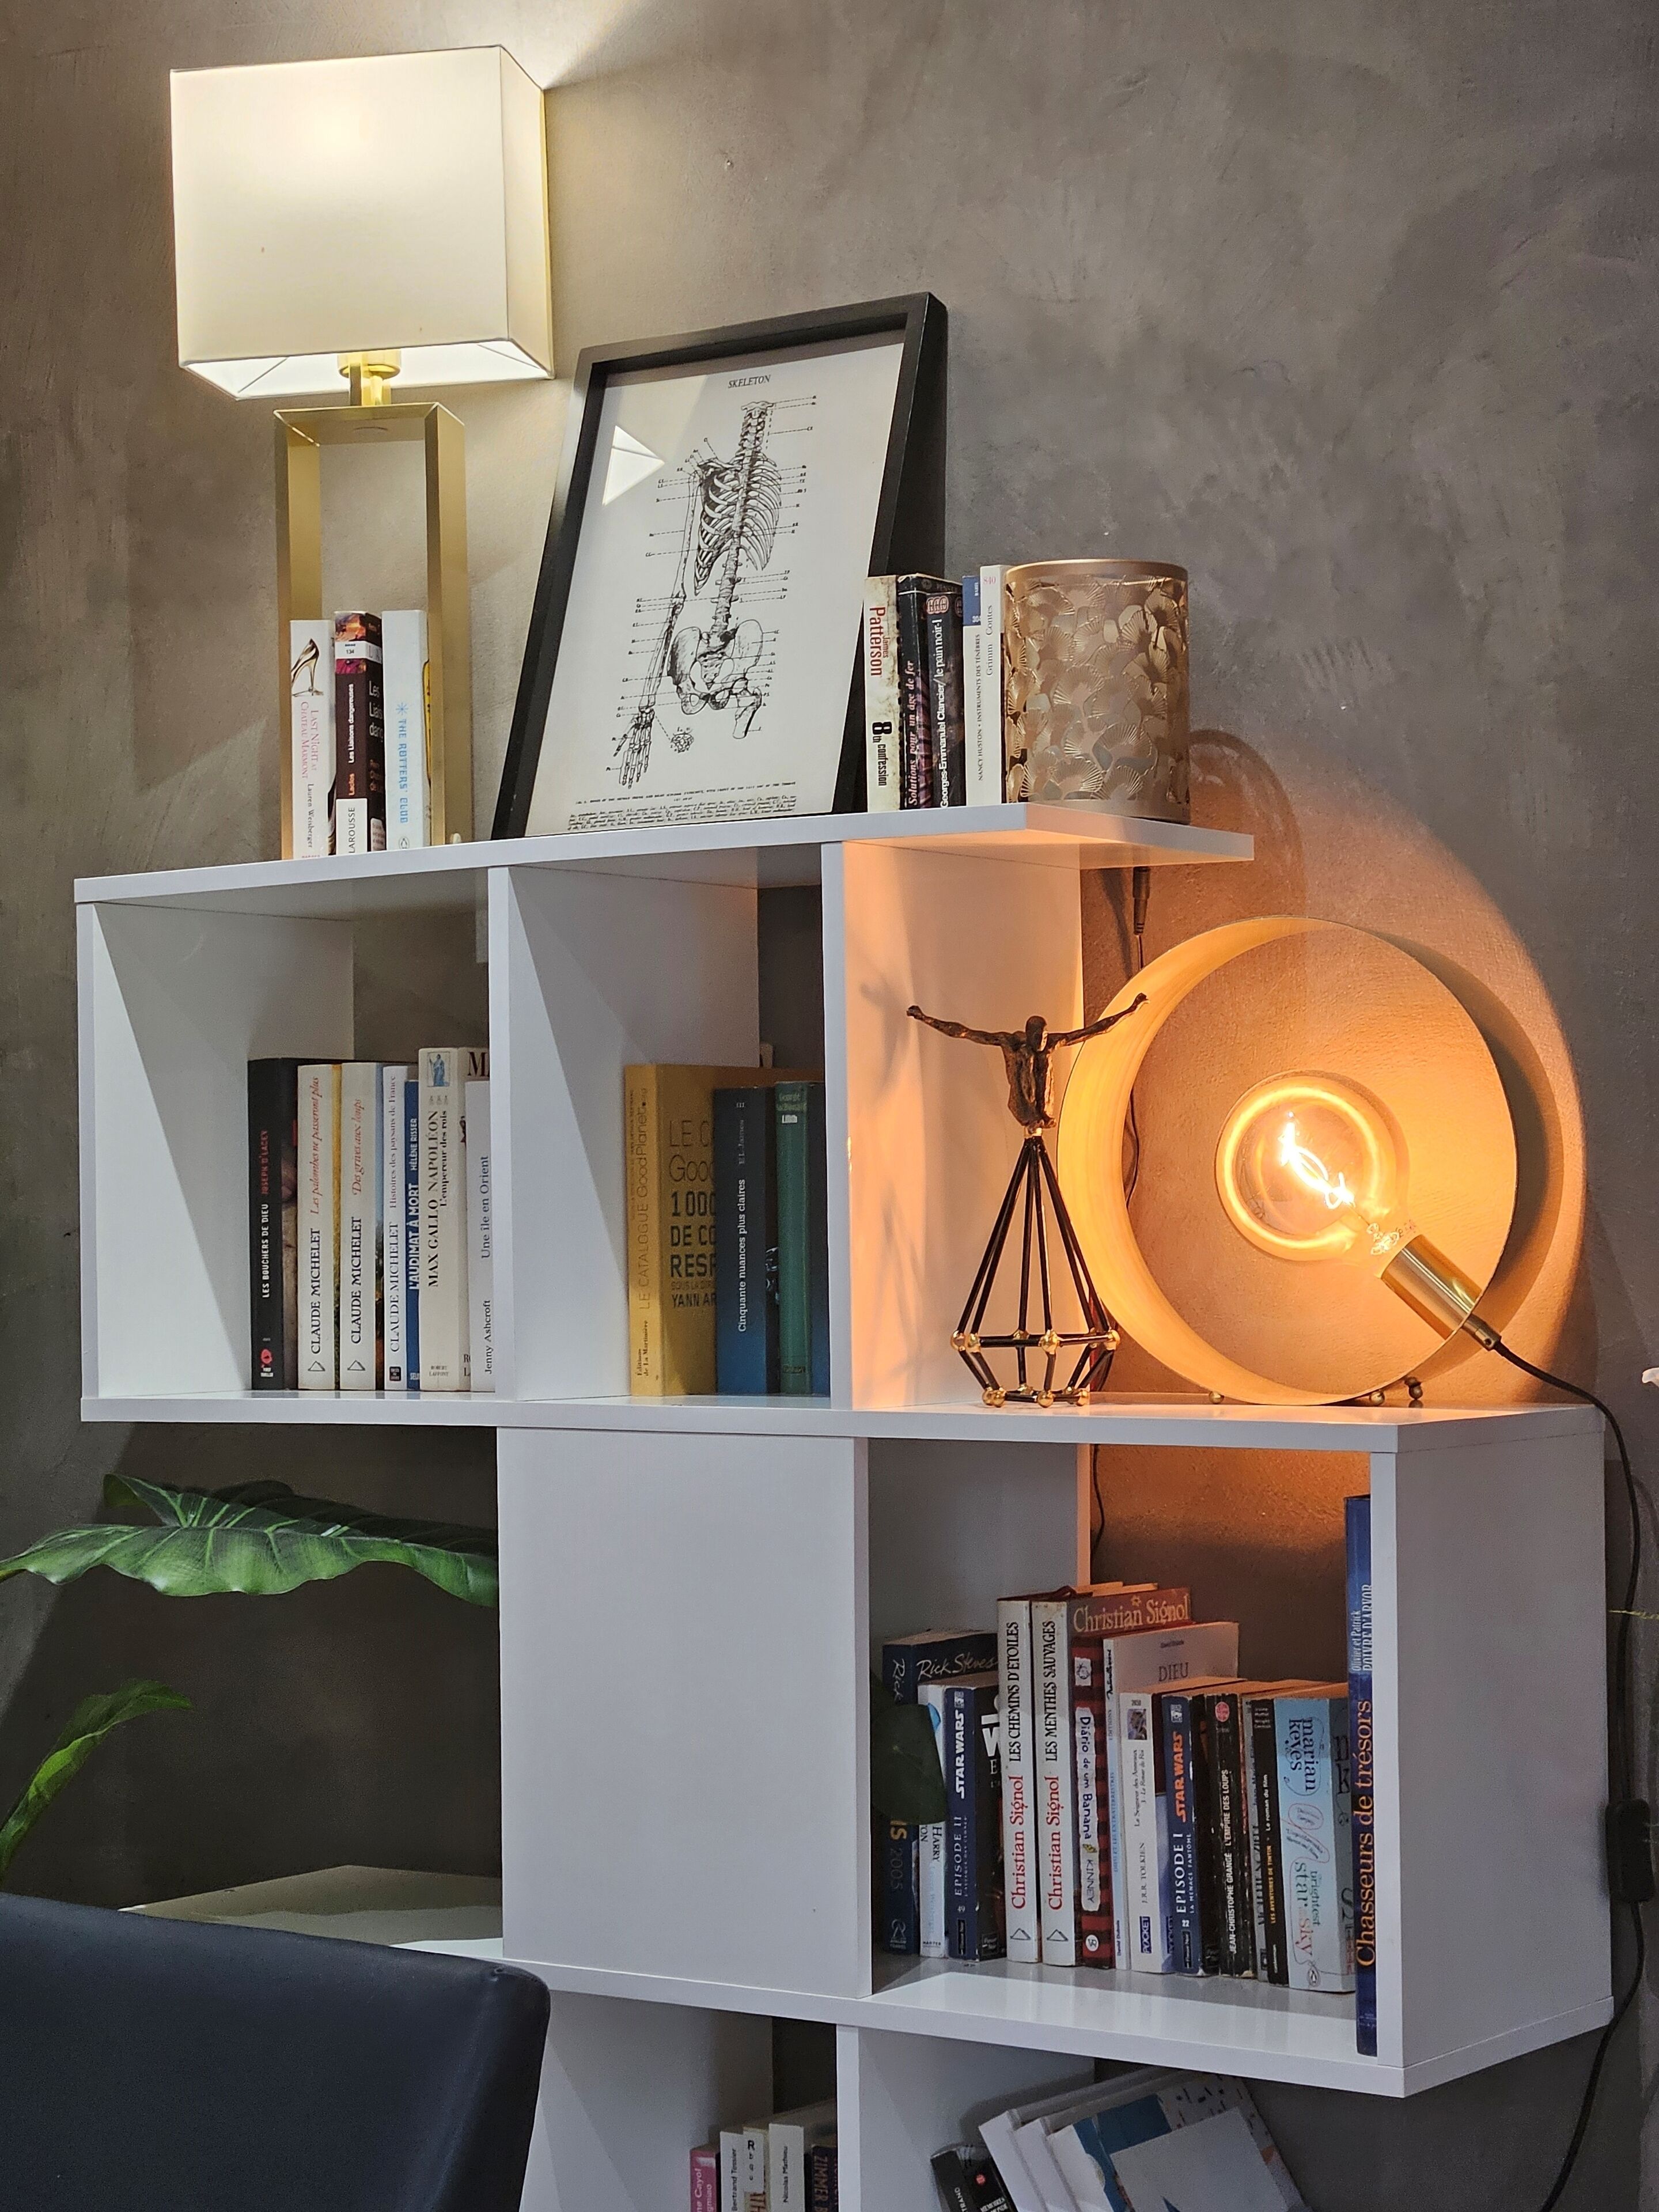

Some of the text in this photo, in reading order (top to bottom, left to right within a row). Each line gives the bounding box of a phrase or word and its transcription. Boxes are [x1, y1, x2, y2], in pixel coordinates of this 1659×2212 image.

[728, 374, 771, 389] SKELETON
[869, 606, 886, 677] Patterson
[882, 635, 891, 658] James
[934, 645, 946, 667] pain
[905, 661, 915, 676] fer
[906, 678, 915, 691] de
[934, 667, 945, 677] le
[300, 701, 309, 779] CHATEAU MARMONT
[310, 710, 319, 730] LAST
[908, 714, 915, 726] un
[872, 721, 892, 786] 8th confession
[908, 732, 919, 755] pour
[399, 718, 408, 823] THE CLUB
[908, 760, 917, 806] Solutions
[306, 809, 315, 848] Weisberger
[669, 1120, 692, 1147] LE
[426, 1110, 438, 1287] MAX GALLO NAPOLÉON
[439, 1150, 449, 1208] L'empereur
[309, 1076, 322, 1355] CLAUDE MICHELET Les palombes ne passeront plus
[351, 1099, 364, 1344] CLAUDE MICHELET Des grives aux loups
[388, 1075, 400, 1353] CLAUDE MICHELET Histoires des paysans de France
[407, 1118, 419, 1290] L'AUDIMAT À MORT RISSER
[261, 1165, 270, 1298] LES BOUCHERS DE DIEU JOSEPH
[670, 1225, 692, 1247] DE
[479, 1156, 494, 1374] Jenny Ashcroft Une île en Orient
[637, 1203, 650, 1310] LE CATALOGUE
[737, 1179, 747, 1332] Cinquante nuances plus claires
[671, 1293, 699, 1309] YANN
[643, 1368, 649, 1377] de
[1073, 1596, 1190, 1633] Christian Signol
[1350, 1610, 1361, 1637] Patrick
[916, 1658, 952, 1681] Rick
[1158, 1662, 1190, 1682] DIEU
[1351, 1647, 1362, 1672] Olivier
[1362, 1631, 1372, 1671] POIVRE
[1006, 1622, 1028, 1910] Christian Signol LES CHEMINS D'ETOILES
[1042, 1620, 1064, 1910] Christian Signol LES MENTHES SAUVAGES
[1173, 1731, 1184, 1777] WARS
[1285, 1718, 1305, 1771] keyes
[1302, 1717, 1320, 1791] marian
[953, 1709, 965, 1896] EPISODE II STAR WARS
[1080, 1716, 1095, 1903] Diário de um Banana KINNEY
[1175, 1777, 1186, 1823] STAR
[1263, 1789, 1270, 1798] du
[932, 1826, 942, 1862] HARRY
[1134, 1818, 1140, 1827] Le
[1266, 1823, 1271, 1832] Le
[1353, 1700, 1375, 1967] Chasseurs de trésors
[889, 1847, 903, 1891] 2005
[1173, 1844, 1187, 1914] EPISODE
[1221, 1769, 1237, 1955] JEAN-CHRISTOPHE L'EMPIRE DES LOUPS
[1268, 1867, 1274, 1876] DE
[1188, 1904, 1195, 1914] LA
[1294, 1862, 1315, 1957] star sky
[1310, 1870, 1321, 1927] brightest
[1141, 1917, 1150, 1953] POCKET
[694, 2168, 704, 2198] Cayol
[814, 2156, 828, 2202] ZIMMER
